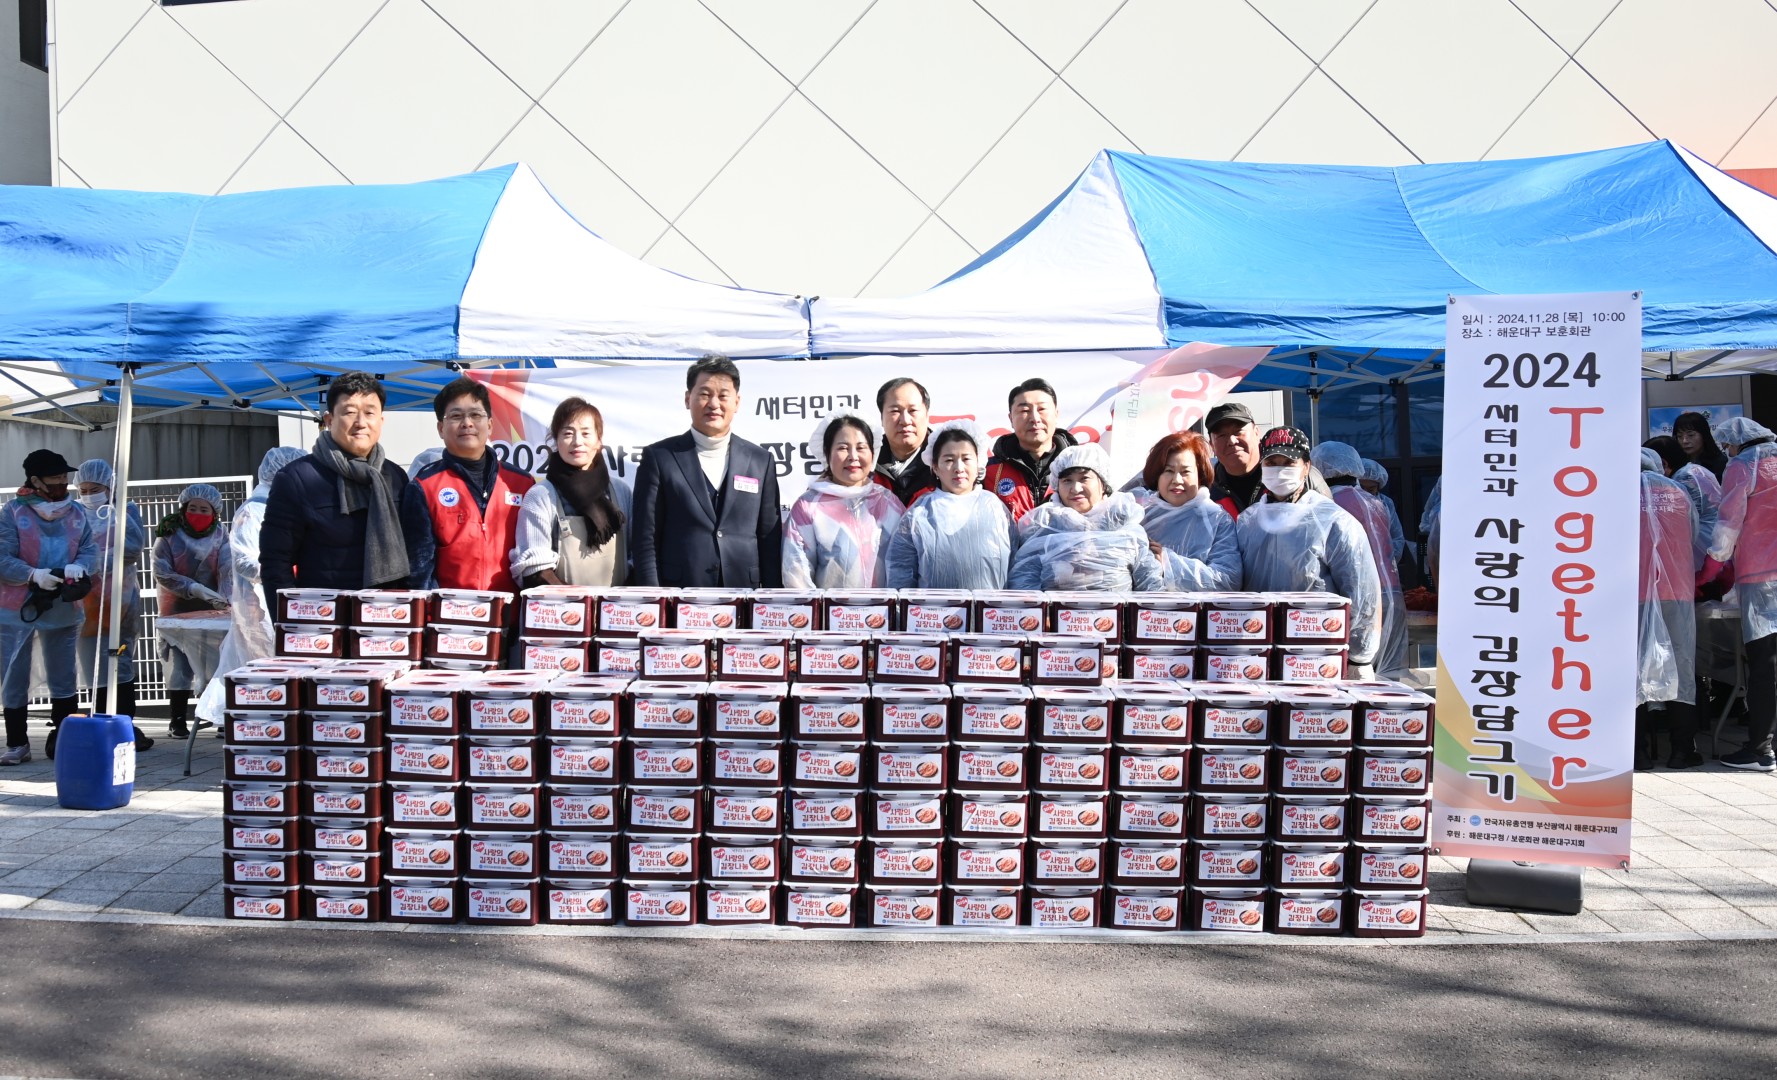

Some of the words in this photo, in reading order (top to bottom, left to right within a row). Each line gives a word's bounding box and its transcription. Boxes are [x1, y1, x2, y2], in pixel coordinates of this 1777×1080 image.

[1462, 314, 1484, 326] 일시
[1497, 313, 1560, 324] 2024.11.28
[1563, 312, 1583, 324] [목]
[1593, 312, 1626, 322] 10:00
[1462, 327, 1484, 339] 장소
[1497, 327, 1542, 338] 해운대구
[1546, 326, 1592, 337] 보훈회관
[1482, 351, 1602, 389] 2024
[1483, 404, 1519, 497] 새터민과
[1474, 517, 1526, 613] 사랑의
[1548, 406, 1605, 788] Together
[995, 615, 1015, 623] 사랑의
[1219, 618, 1239, 626] 사랑의
[1299, 616, 1319, 625] 사랑의
[991, 623, 1019, 631] 김장나눔
[1215, 625, 1243, 634] 김장나눔
[1295, 624, 1322, 632] 김장나눔
[656, 652, 677, 661] 사랑의
[734, 652, 756, 661] 사랑의
[813, 653, 835, 662] 사랑의
[890, 653, 912, 662] 사랑의
[1050, 655, 1071, 664] 사랑의
[652, 660, 681, 669] 김장나눔
[730, 660, 759, 669] 김장나눔
[809, 661, 838, 669] 김장나눔
[886, 661, 915, 670] 김장나눔
[1046, 663, 1075, 672] 김장나눔
[403, 704, 424, 713] 사랑의
[483, 707, 504, 715] 사랑의
[563, 707, 585, 716] 사랑의
[729, 709, 750, 717] 사랑의
[399, 712, 428, 721] 김장나눔
[479, 715, 508, 724] 김장나눔
[812, 711, 834, 719] 사랑의
[896, 712, 917, 720] 사랑의
[1056, 714, 1078, 723] 사랑의
[1136, 713, 1158, 722] 사랑의
[1468, 635, 1522, 801] 김장담그기
[559, 716, 589, 724] 김장나눔
[725, 717, 754, 726] 김장나눔
[808, 719, 838, 728] 김장나눔
[892, 720, 921, 729] 김장나눔
[1302, 717, 1323, 726] 사랑의
[1377, 717, 1399, 726] 사랑의
[1052, 722, 1082, 731] 김장나눔
[1132, 722, 1162, 730] 김장나눔
[1298, 725, 1327, 734] 김장나눔
[1373, 725, 1402, 734] 김장나눔
[482, 754, 503, 763] 사랑의
[563, 754, 585, 763] 사랑의
[647, 756, 668, 764] 사랑의
[728, 756, 750, 765] 사랑의
[478, 762, 507, 771] 김장나눔
[559, 762, 588, 771] 김장나눔
[891, 761, 912, 769] 사랑의
[972, 759, 994, 768] 사랑의
[1053, 761, 1075, 770] 사랑의
[1132, 763, 1154, 772] 사랑의
[1214, 762, 1235, 771] 사랑의
[643, 764, 672, 773] 김장나눔
[724, 765, 753, 773] 김장나눔
[968, 768, 997, 776] 김장나눔
[1296, 765, 1317, 774] 사랑의
[1376, 766, 1397, 775] 사랑의
[887, 769, 916, 778] 김장나눔
[1049, 770, 1079, 778] 김장나눔
[1128, 772, 1158, 780] 김장나눔
[1210, 770, 1239, 779] 김장나눔
[1292, 773, 1321, 782] 김장나눔
[1372, 774, 1401, 782] 김장나눔
[405, 799, 427, 808] 사랑의
[484, 801, 506, 810] 사랑의
[563, 803, 584, 812] 사랑의
[401, 807, 430, 816] 김장나눔
[480, 809, 509, 817] 김장나눔
[726, 804, 748, 813] 사랑의
[559, 811, 588, 820] 김장나눔
[722, 813, 752, 821] 김장나눔
[1052, 809, 1074, 818] 사랑의
[1295, 813, 1316, 822] 사랑의
[1375, 813, 1397, 822] 사랑의
[1048, 817, 1078, 826] 김장나눔
[1291, 821, 1320, 829] 김장나눔
[1371, 821, 1400, 830] 김장나눔
[1446, 814, 1461, 823] 주최
[1535, 821, 1572, 831] 부산광역시
[1573, 824, 1618, 834] 해운대구지회
[1446, 830, 1461, 839] 후원
[1511, 834, 1540, 844] 보훈회관
[1541, 837, 1586, 847] 해운대구지회
[404, 847, 426, 856] 사랑의
[562, 849, 583, 858] 사랑의
[641, 850, 663, 859] 사랑의
[400, 855, 429, 864] 김장나눔
[558, 857, 587, 865] 김장나눔
[637, 858, 667, 867] 김장나눔
[970, 856, 992, 865] 사랑의
[1049, 856, 1071, 864] 사랑의
[1131, 854, 1152, 863] 사랑의
[966, 864, 996, 873] 김장나눔
[1045, 864, 1075, 873] 김장나눔
[1127, 862, 1156, 871] 김장나눔
[1374, 861, 1395, 870] 사랑의
[1370, 869, 1399, 878] 김장나눔
[403, 895, 424, 904] 사랑의
[481, 896, 502, 905] 사랑의
[640, 898, 662, 907] 사랑의
[399, 903, 428, 911] 김장나눔
[477, 904, 506, 913] 김장나눔
[636, 907, 665, 915] 김장나눔
[886, 903, 908, 912] 사랑의
[966, 903, 987, 912] 사랑의
[1044, 905, 1065, 914] 사랑의
[1371, 907, 1392, 916] 사랑의
[882, 911, 912, 920] 김장나눔
[962, 911, 991, 920] 김장나눔
[1040, 913, 1069, 922] 김장나눔
[1367, 915, 1396, 924] 김장나눔
